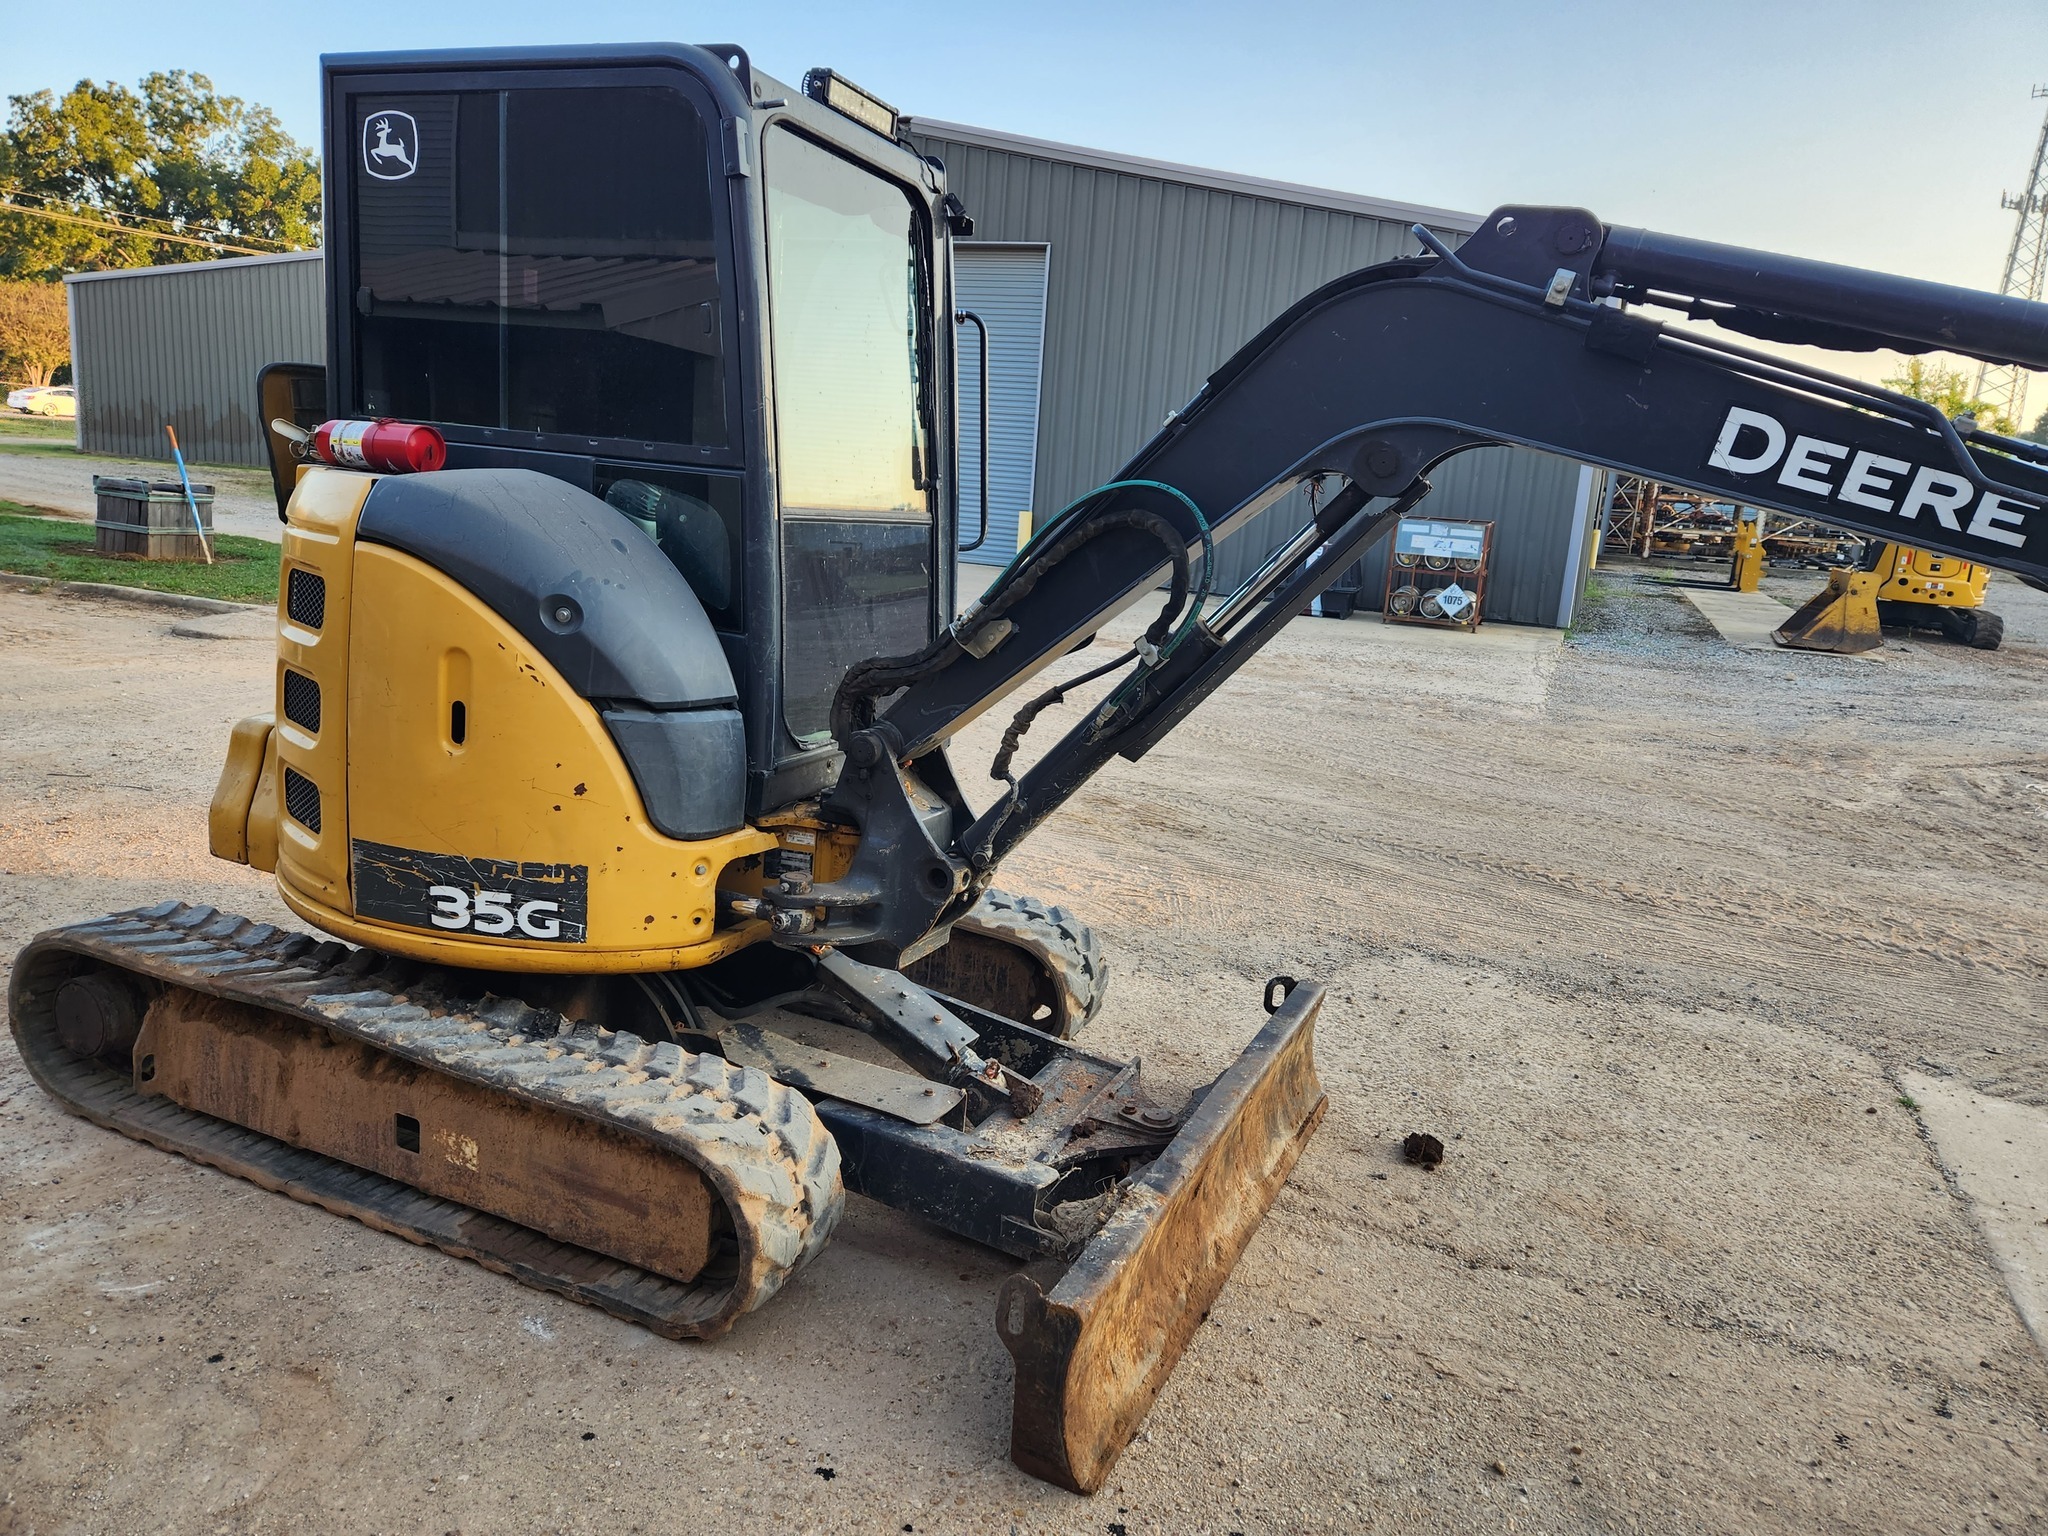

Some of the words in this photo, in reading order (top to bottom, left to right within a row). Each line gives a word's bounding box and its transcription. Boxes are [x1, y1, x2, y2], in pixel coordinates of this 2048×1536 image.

[1708, 406, 2040, 548] DEERE
[1443, 595, 1463, 606] 1075
[429, 885, 560, 939] 35G
